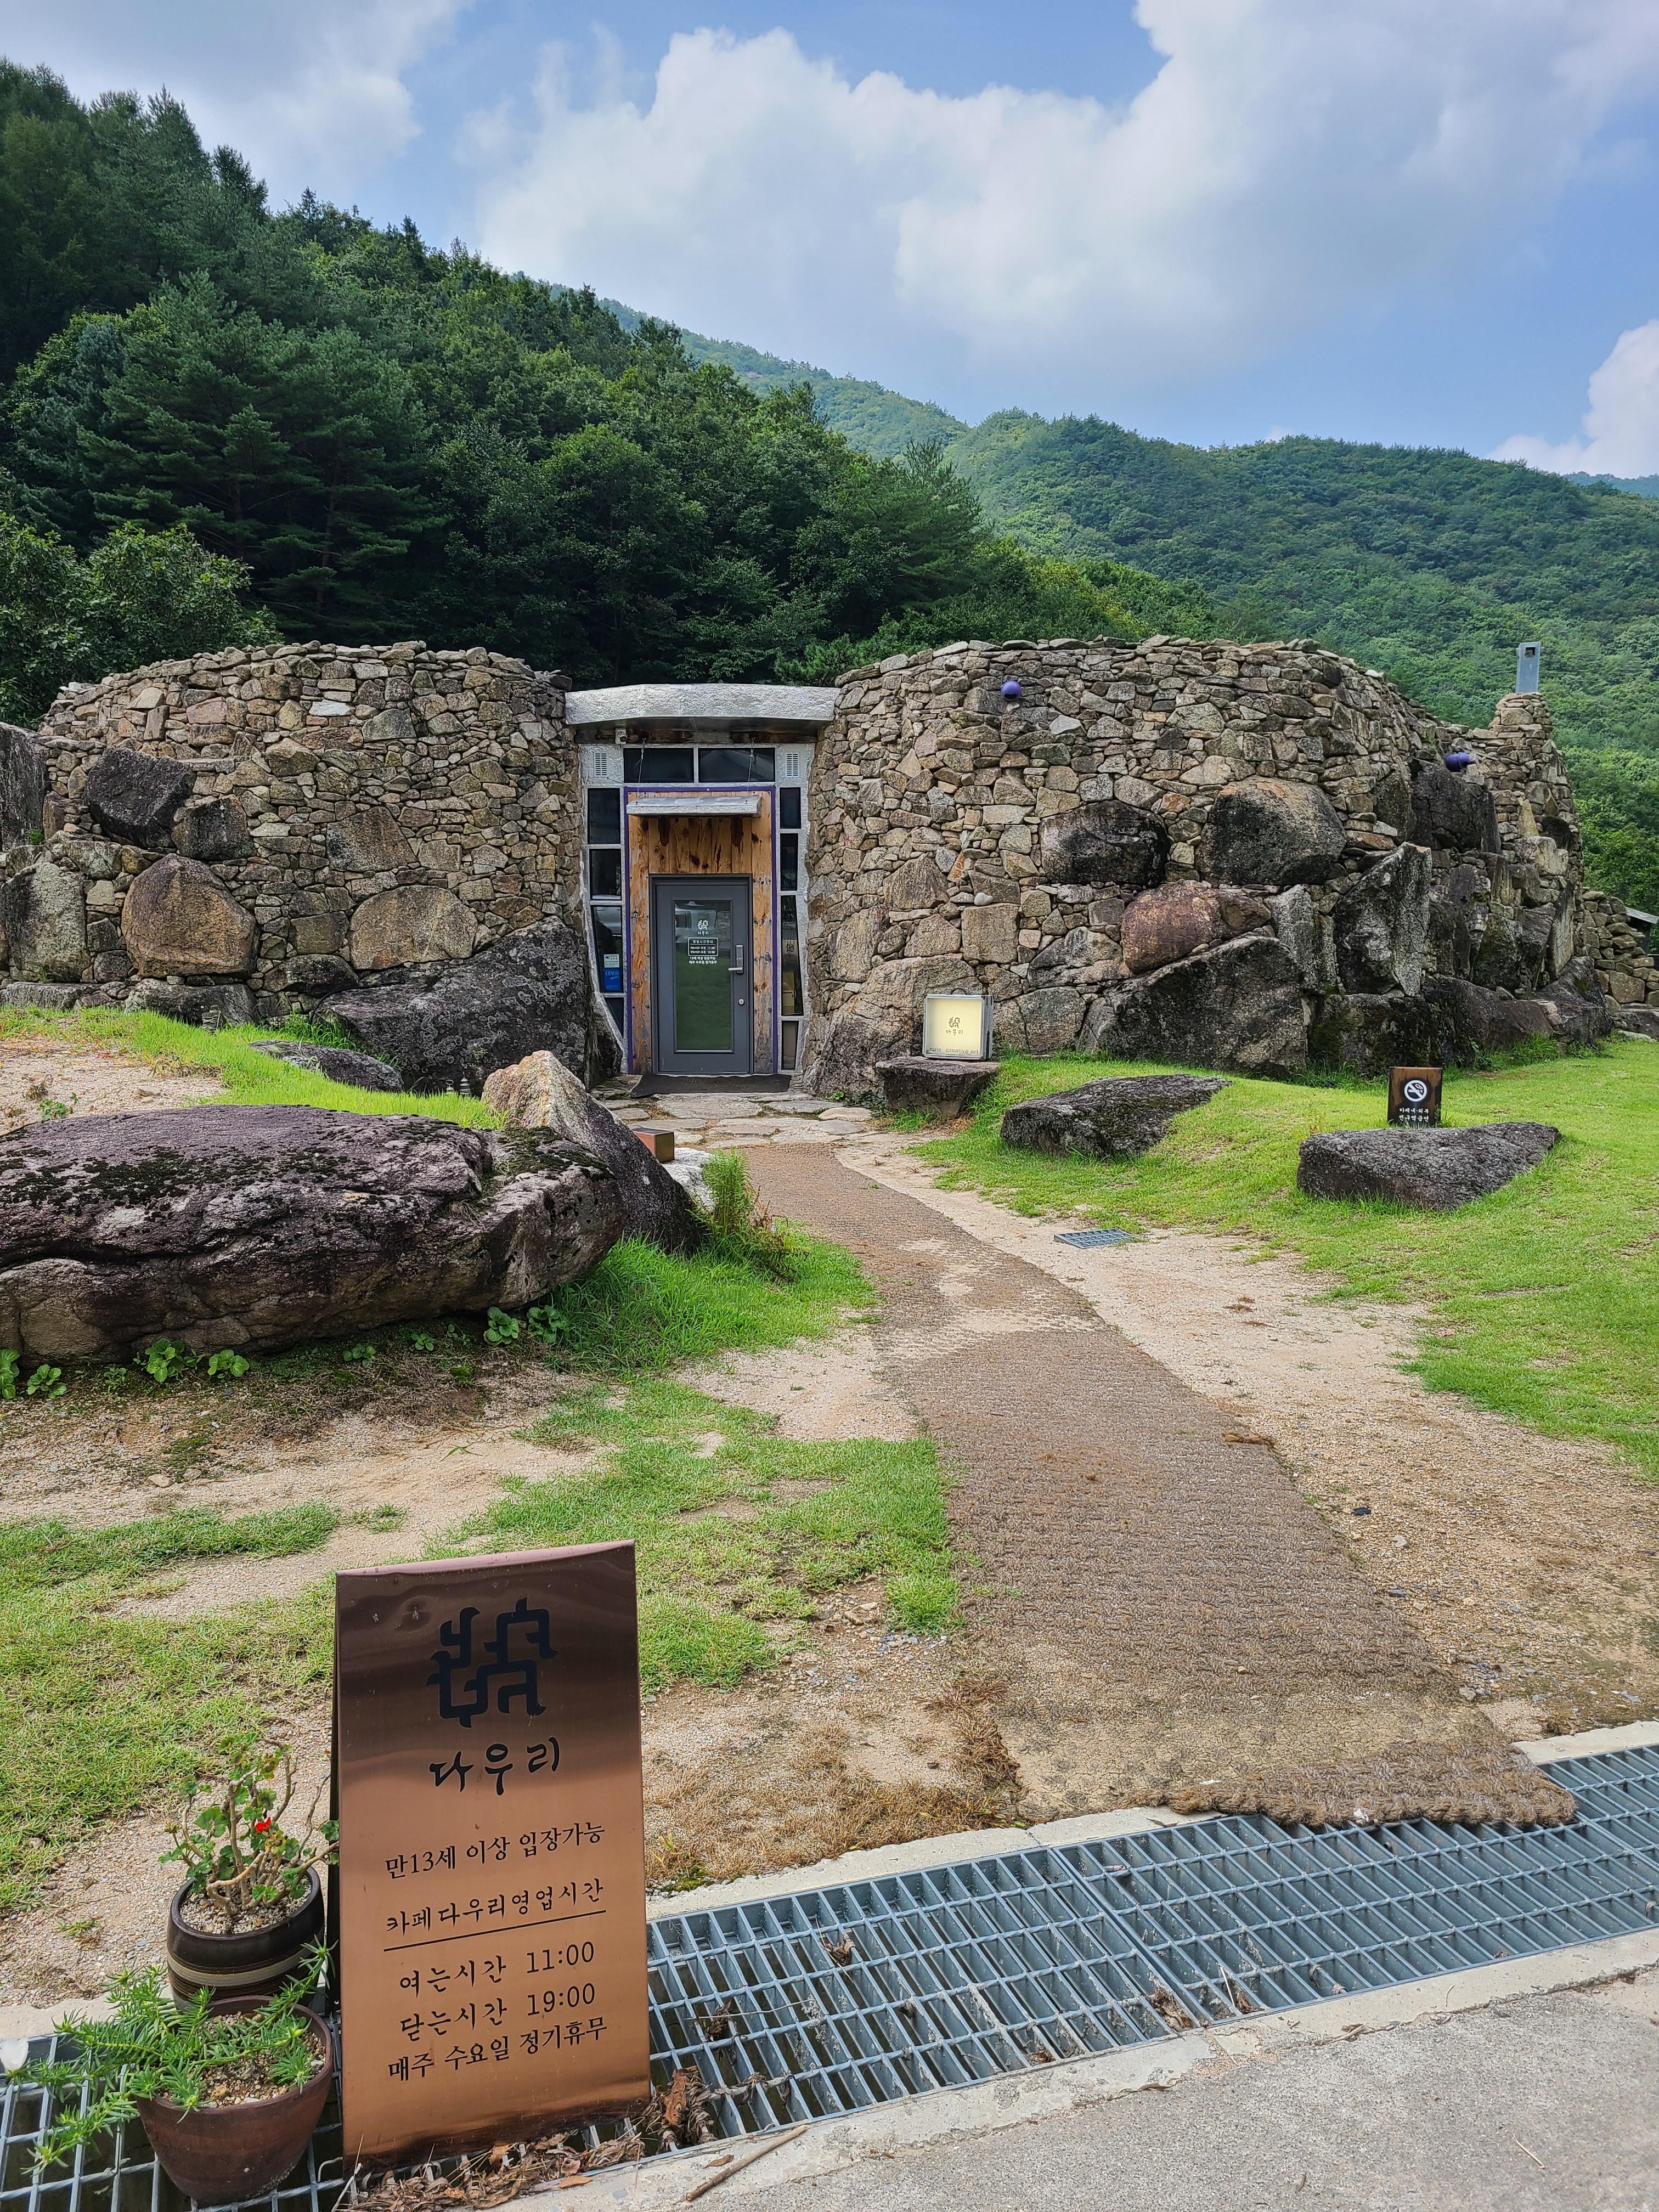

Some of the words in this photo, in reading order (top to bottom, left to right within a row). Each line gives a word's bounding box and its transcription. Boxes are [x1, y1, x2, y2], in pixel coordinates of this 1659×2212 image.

[429, 1736, 560, 1796] 다우리
[385, 1846, 456, 1879] 만13세
[466, 1836, 510, 1864] 이상
[519, 1821, 605, 1858] 입장가능
[400, 1955, 506, 1998] 여는시간
[526, 1941, 595, 1974] 11:00
[400, 1997, 507, 2042] 닫는시간
[527, 1983, 595, 2016] 19:00
[388, 2052, 435, 2081] 매주
[444, 2036, 510, 2070] 수요일
[519, 2016, 607, 2054] 정기휴무
